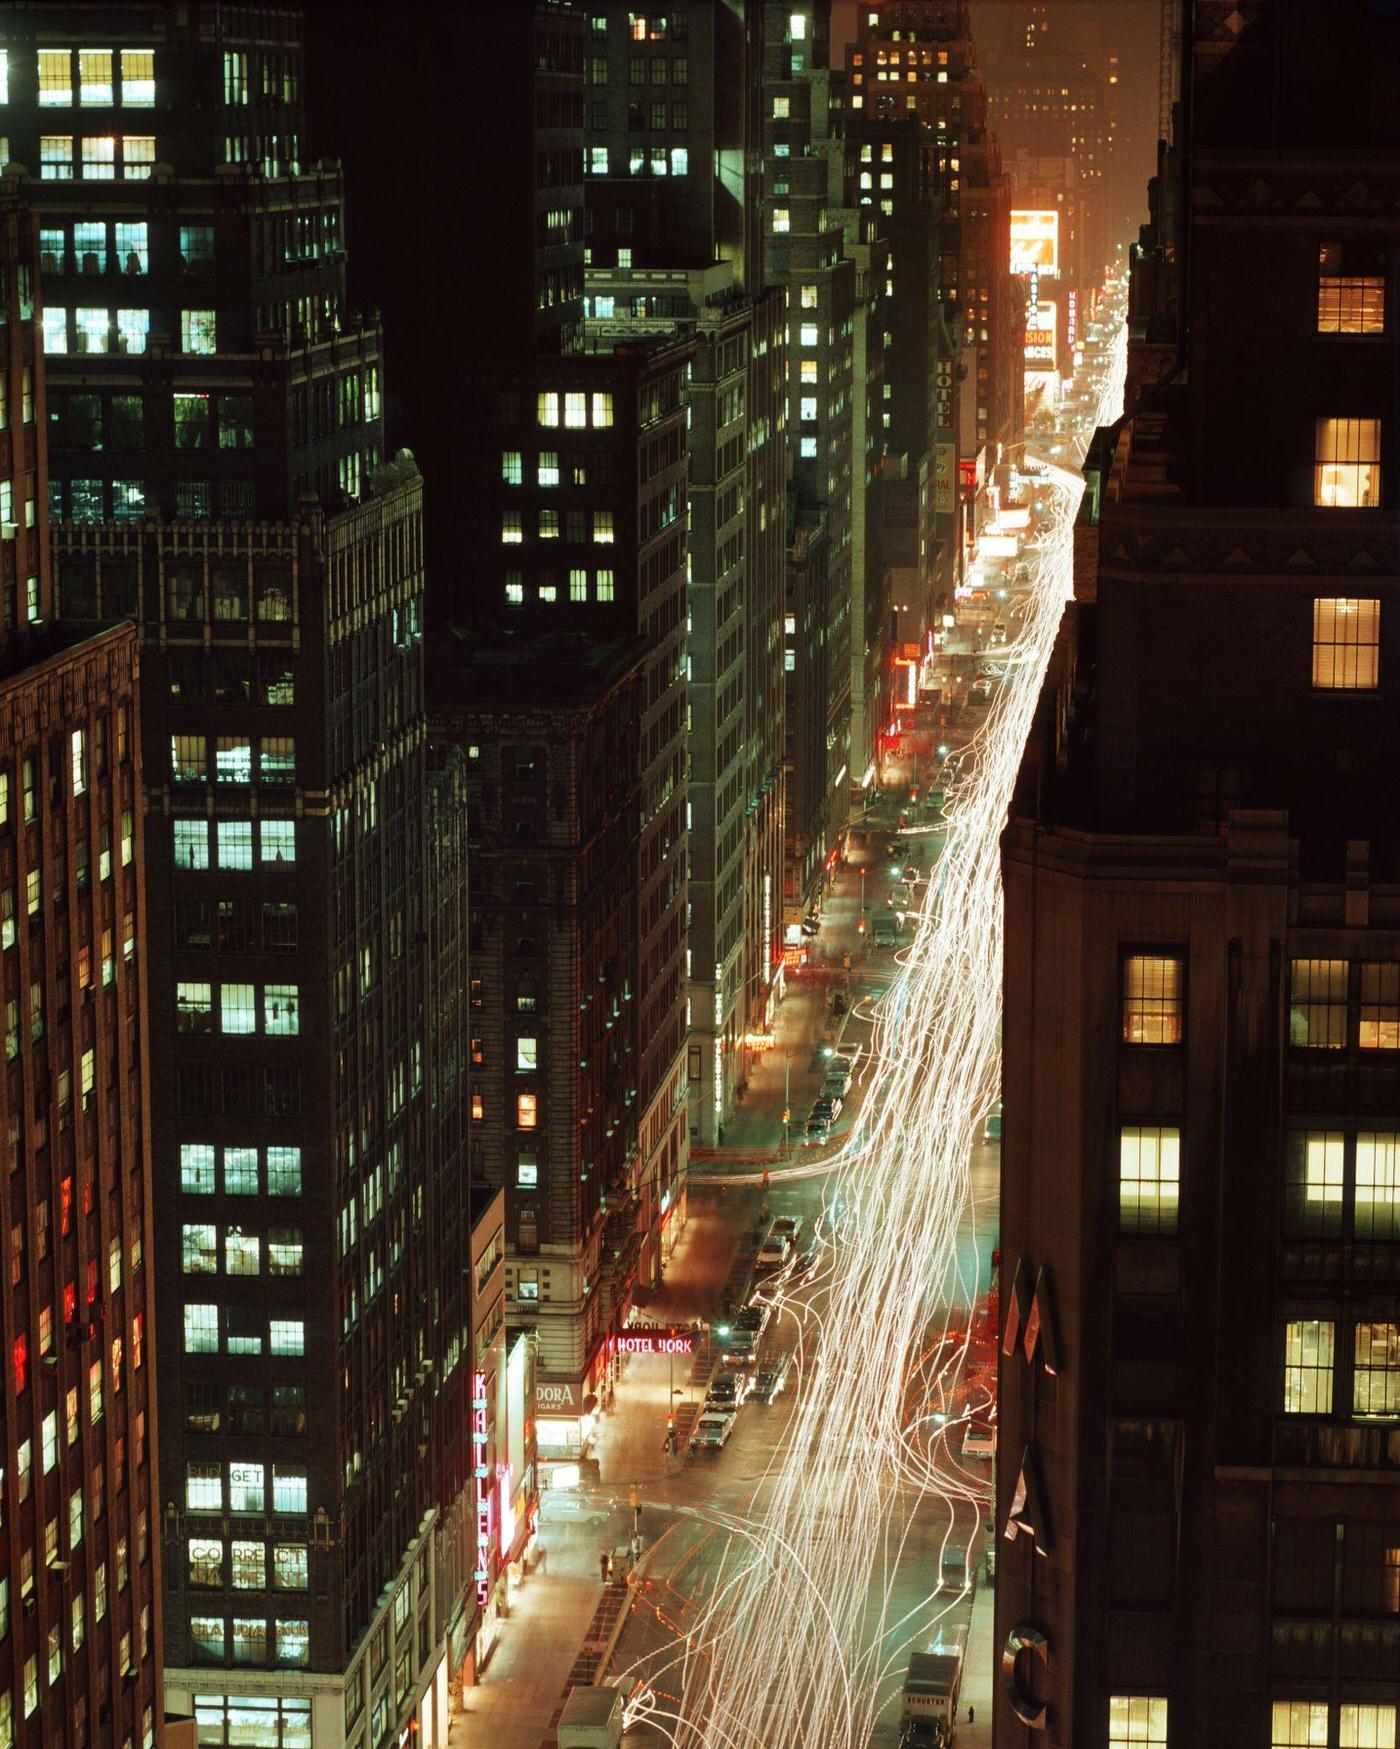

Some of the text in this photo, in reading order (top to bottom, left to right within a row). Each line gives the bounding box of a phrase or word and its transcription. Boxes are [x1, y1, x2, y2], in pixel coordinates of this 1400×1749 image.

[936, 361, 952, 427] HOTEL
[617, 1337, 692, 1353] HOTEL YORK
